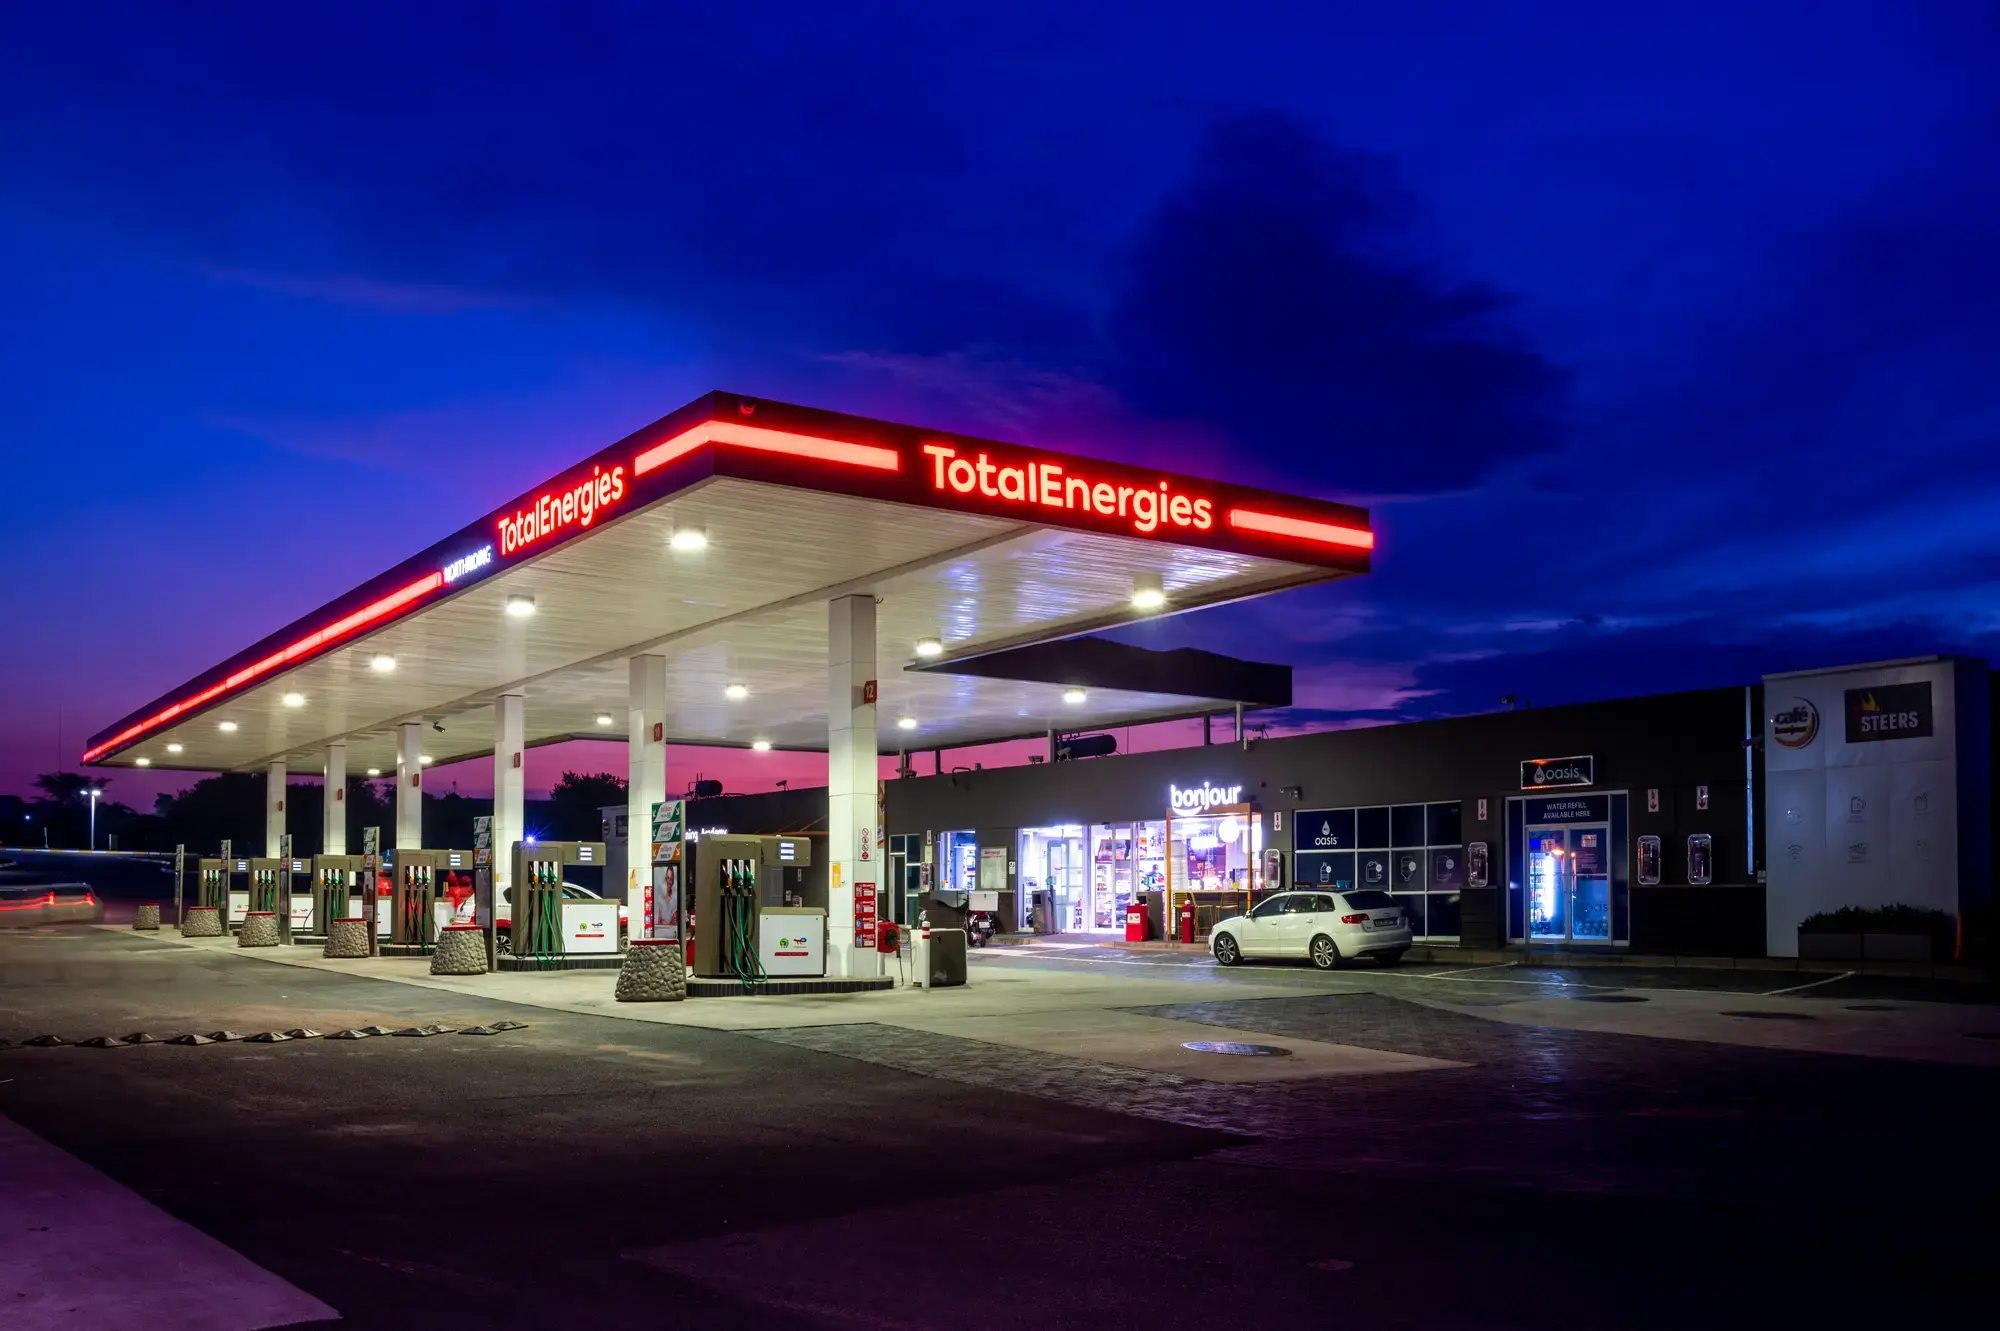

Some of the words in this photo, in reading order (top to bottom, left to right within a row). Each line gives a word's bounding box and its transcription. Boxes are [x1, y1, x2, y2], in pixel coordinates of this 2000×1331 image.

[924, 444, 1213, 533] TotalEnergies
[498, 465, 624, 556] TotalEnergies
[1775, 706, 1808, 724] café
[1861, 711, 1919, 732] STEERS
[1545, 763, 1580, 780] oasis
[1170, 781, 1242, 810] bonjour
[1543, 810, 1575, 820] AVAILABLE
[1575, 809, 1591, 817] HERE
[1546, 802, 1567, 811] WATER
[1567, 801, 1587, 809] REFILL
[1314, 833, 1338, 846] oasis
